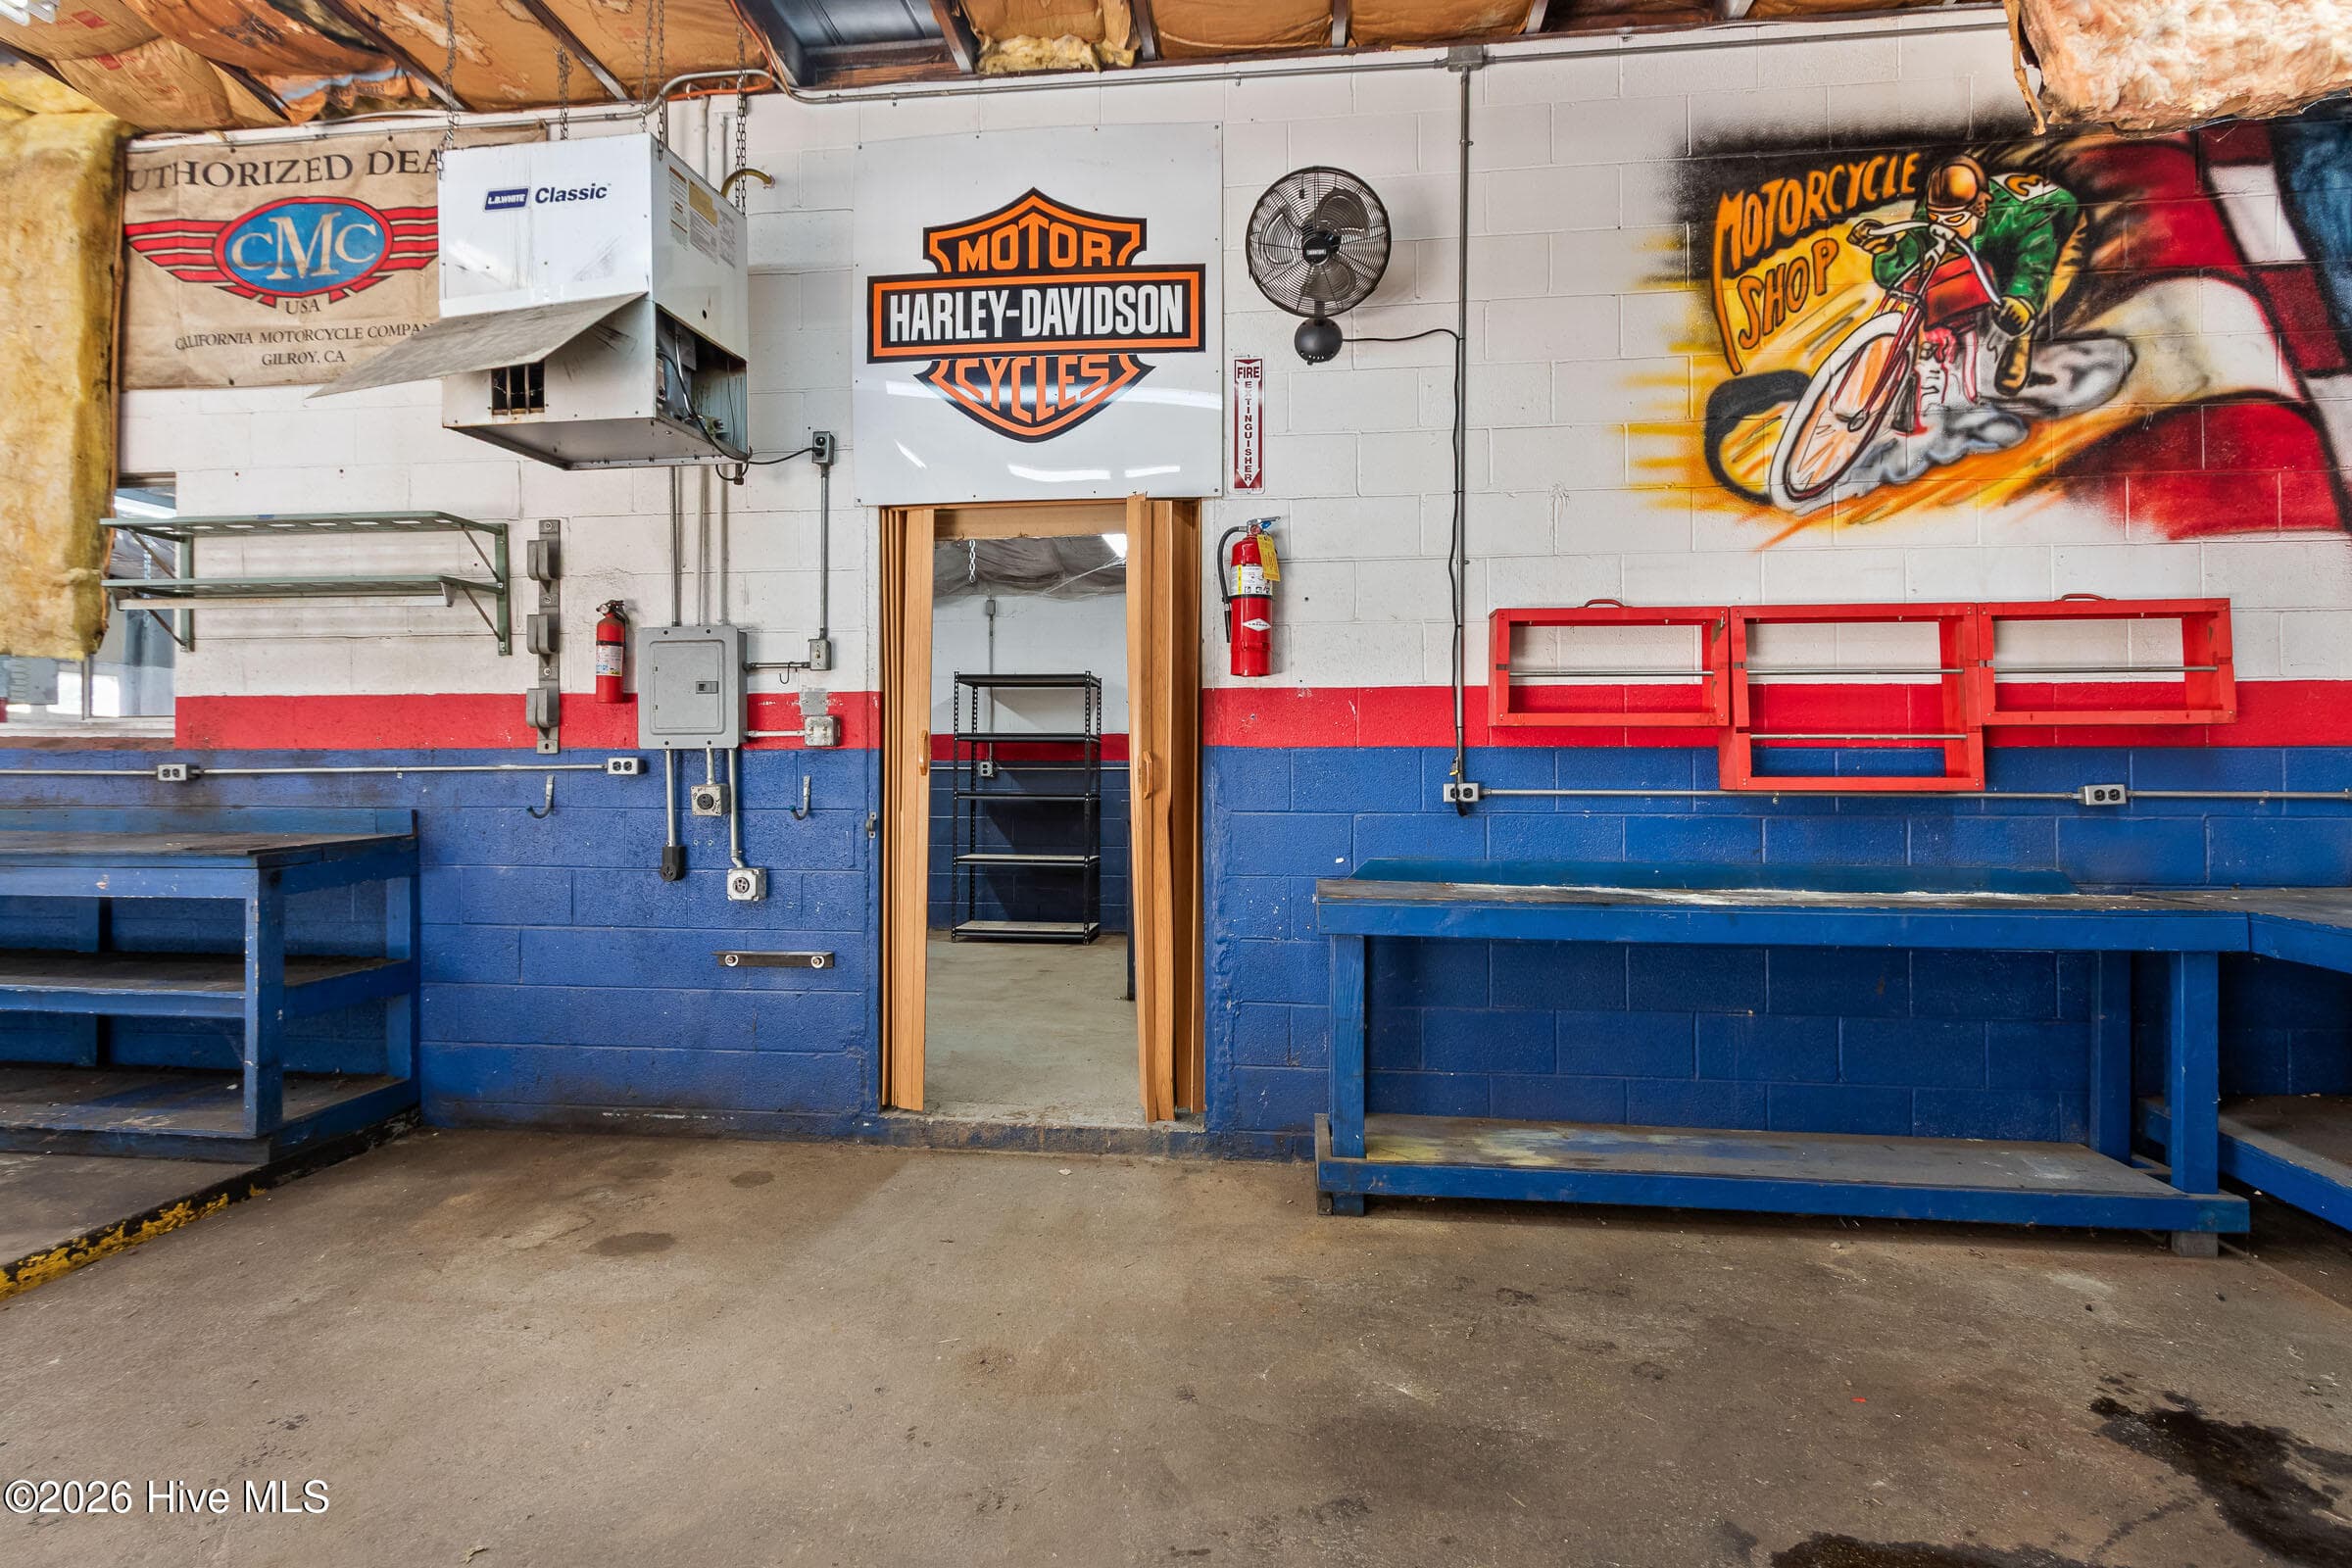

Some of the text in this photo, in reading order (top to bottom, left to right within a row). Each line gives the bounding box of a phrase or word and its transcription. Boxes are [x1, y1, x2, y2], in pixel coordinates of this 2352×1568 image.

[535, 182, 607, 204] Classic
[1713, 151, 1921, 271] MOTORCYCLE
[231, 211, 376, 280] CMC
[957, 212, 1111, 271] MOTOR
[285, 298, 320, 315] USA
[889, 284, 1183, 342] HARLEY-DAVIDSON
[1736, 237, 1840, 351] SHOP
[259, 326, 363, 344] MOTORCYCLE
[367, 322, 432, 338] COMPA
[262, 349, 346, 367] GILROY, CA
[955, 354, 1110, 423] CYCLES
[1237, 367, 1260, 379] FIRE
